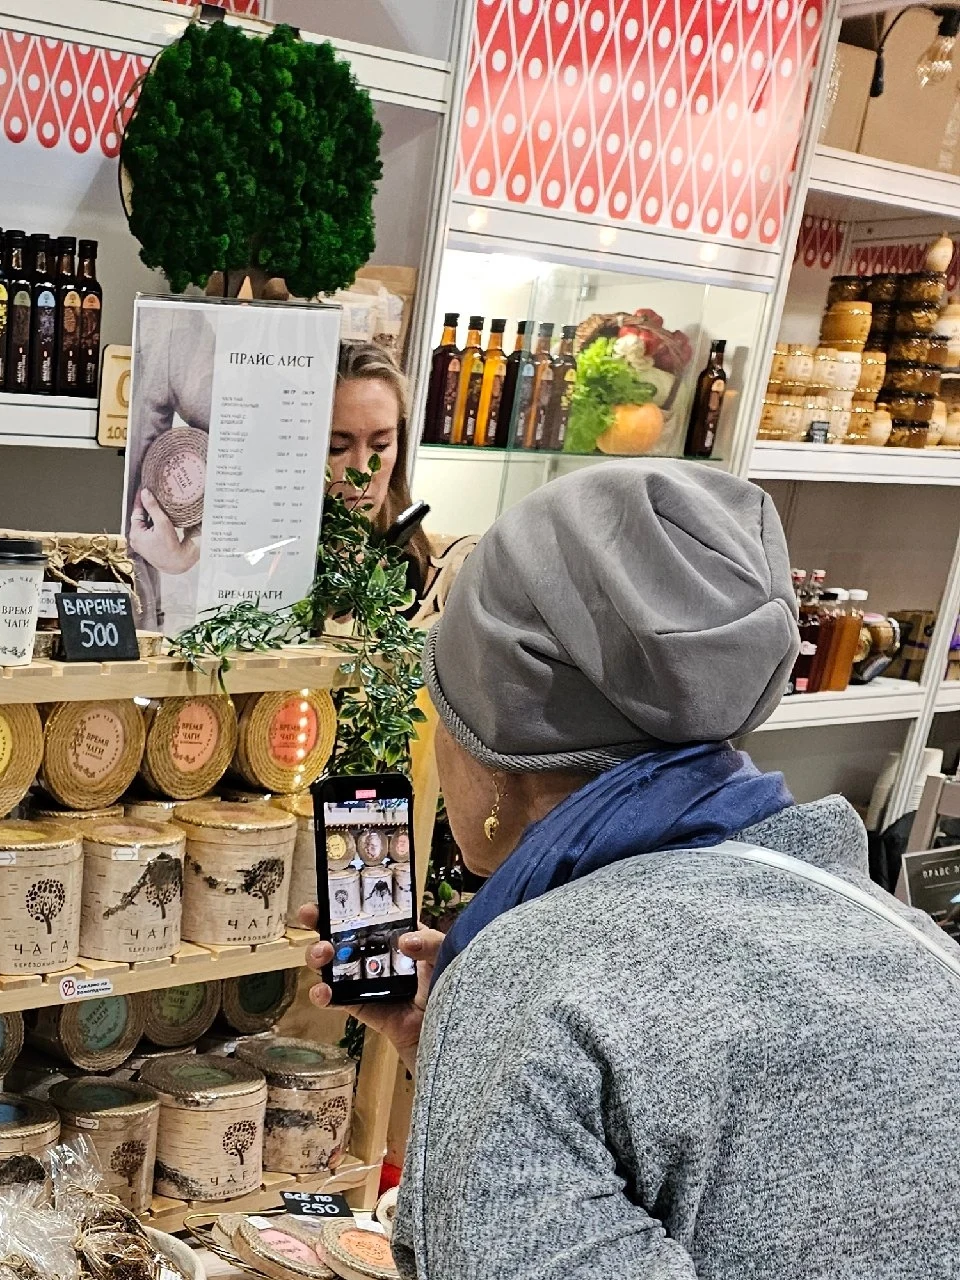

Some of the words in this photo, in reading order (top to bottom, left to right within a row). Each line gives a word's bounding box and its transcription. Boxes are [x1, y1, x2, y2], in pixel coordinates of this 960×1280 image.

[229, 351, 275, 367] ПРАЙС
[277, 354, 315, 368] ЛИСТ
[1, 604, 34, 615] ВРЕМЯ
[62, 598, 128, 616] ВАРЕНЬЕ
[4, 618, 30, 628] ЧАГИ
[80, 620, 119, 648] 500
[227, 913, 284, 930] ЧАГА
[14, 940, 69, 955] ЧАГА
[300, 1203, 340, 1214] 250
